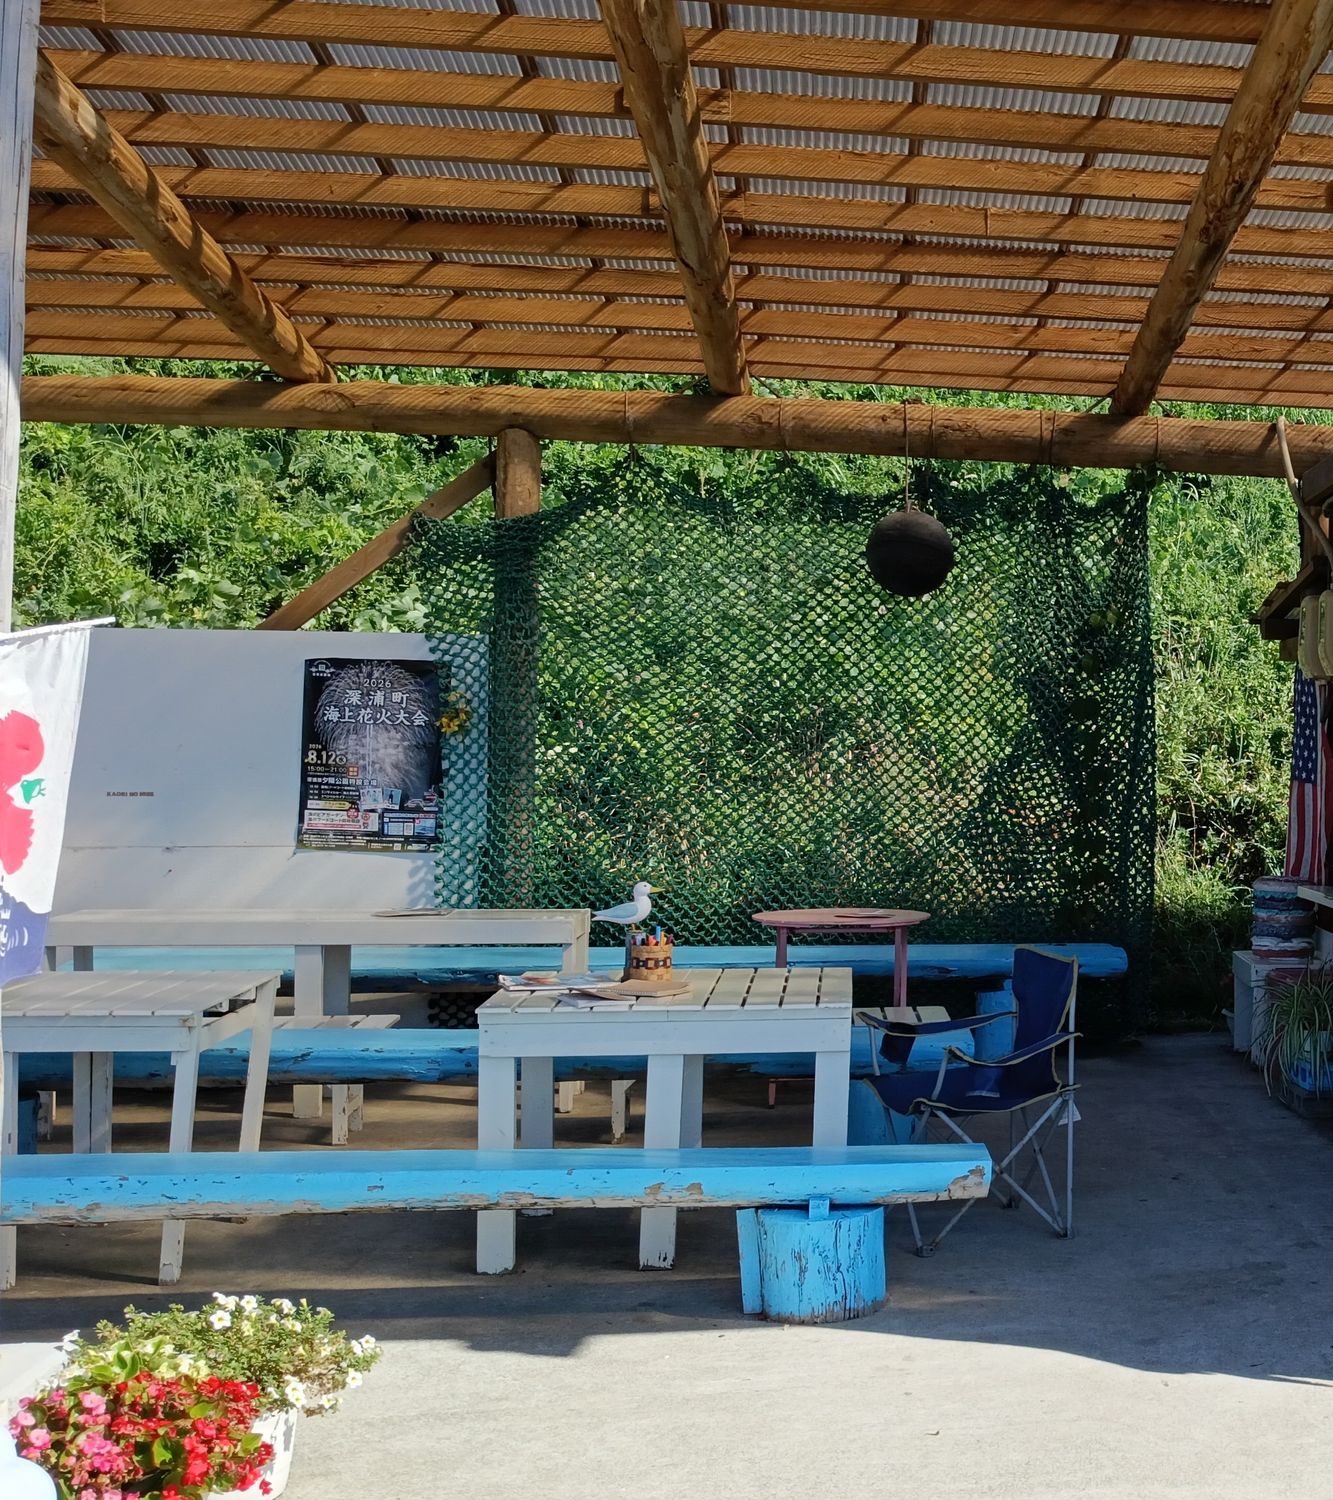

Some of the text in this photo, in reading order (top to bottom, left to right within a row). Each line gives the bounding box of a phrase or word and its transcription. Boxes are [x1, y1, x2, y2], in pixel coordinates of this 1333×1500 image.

[363, 679, 392, 688] 2026
[344, 689, 410, 708] 深浦町
[323, 706, 430, 727] 海上花火大会
[308, 750, 336, 765] 8.12
